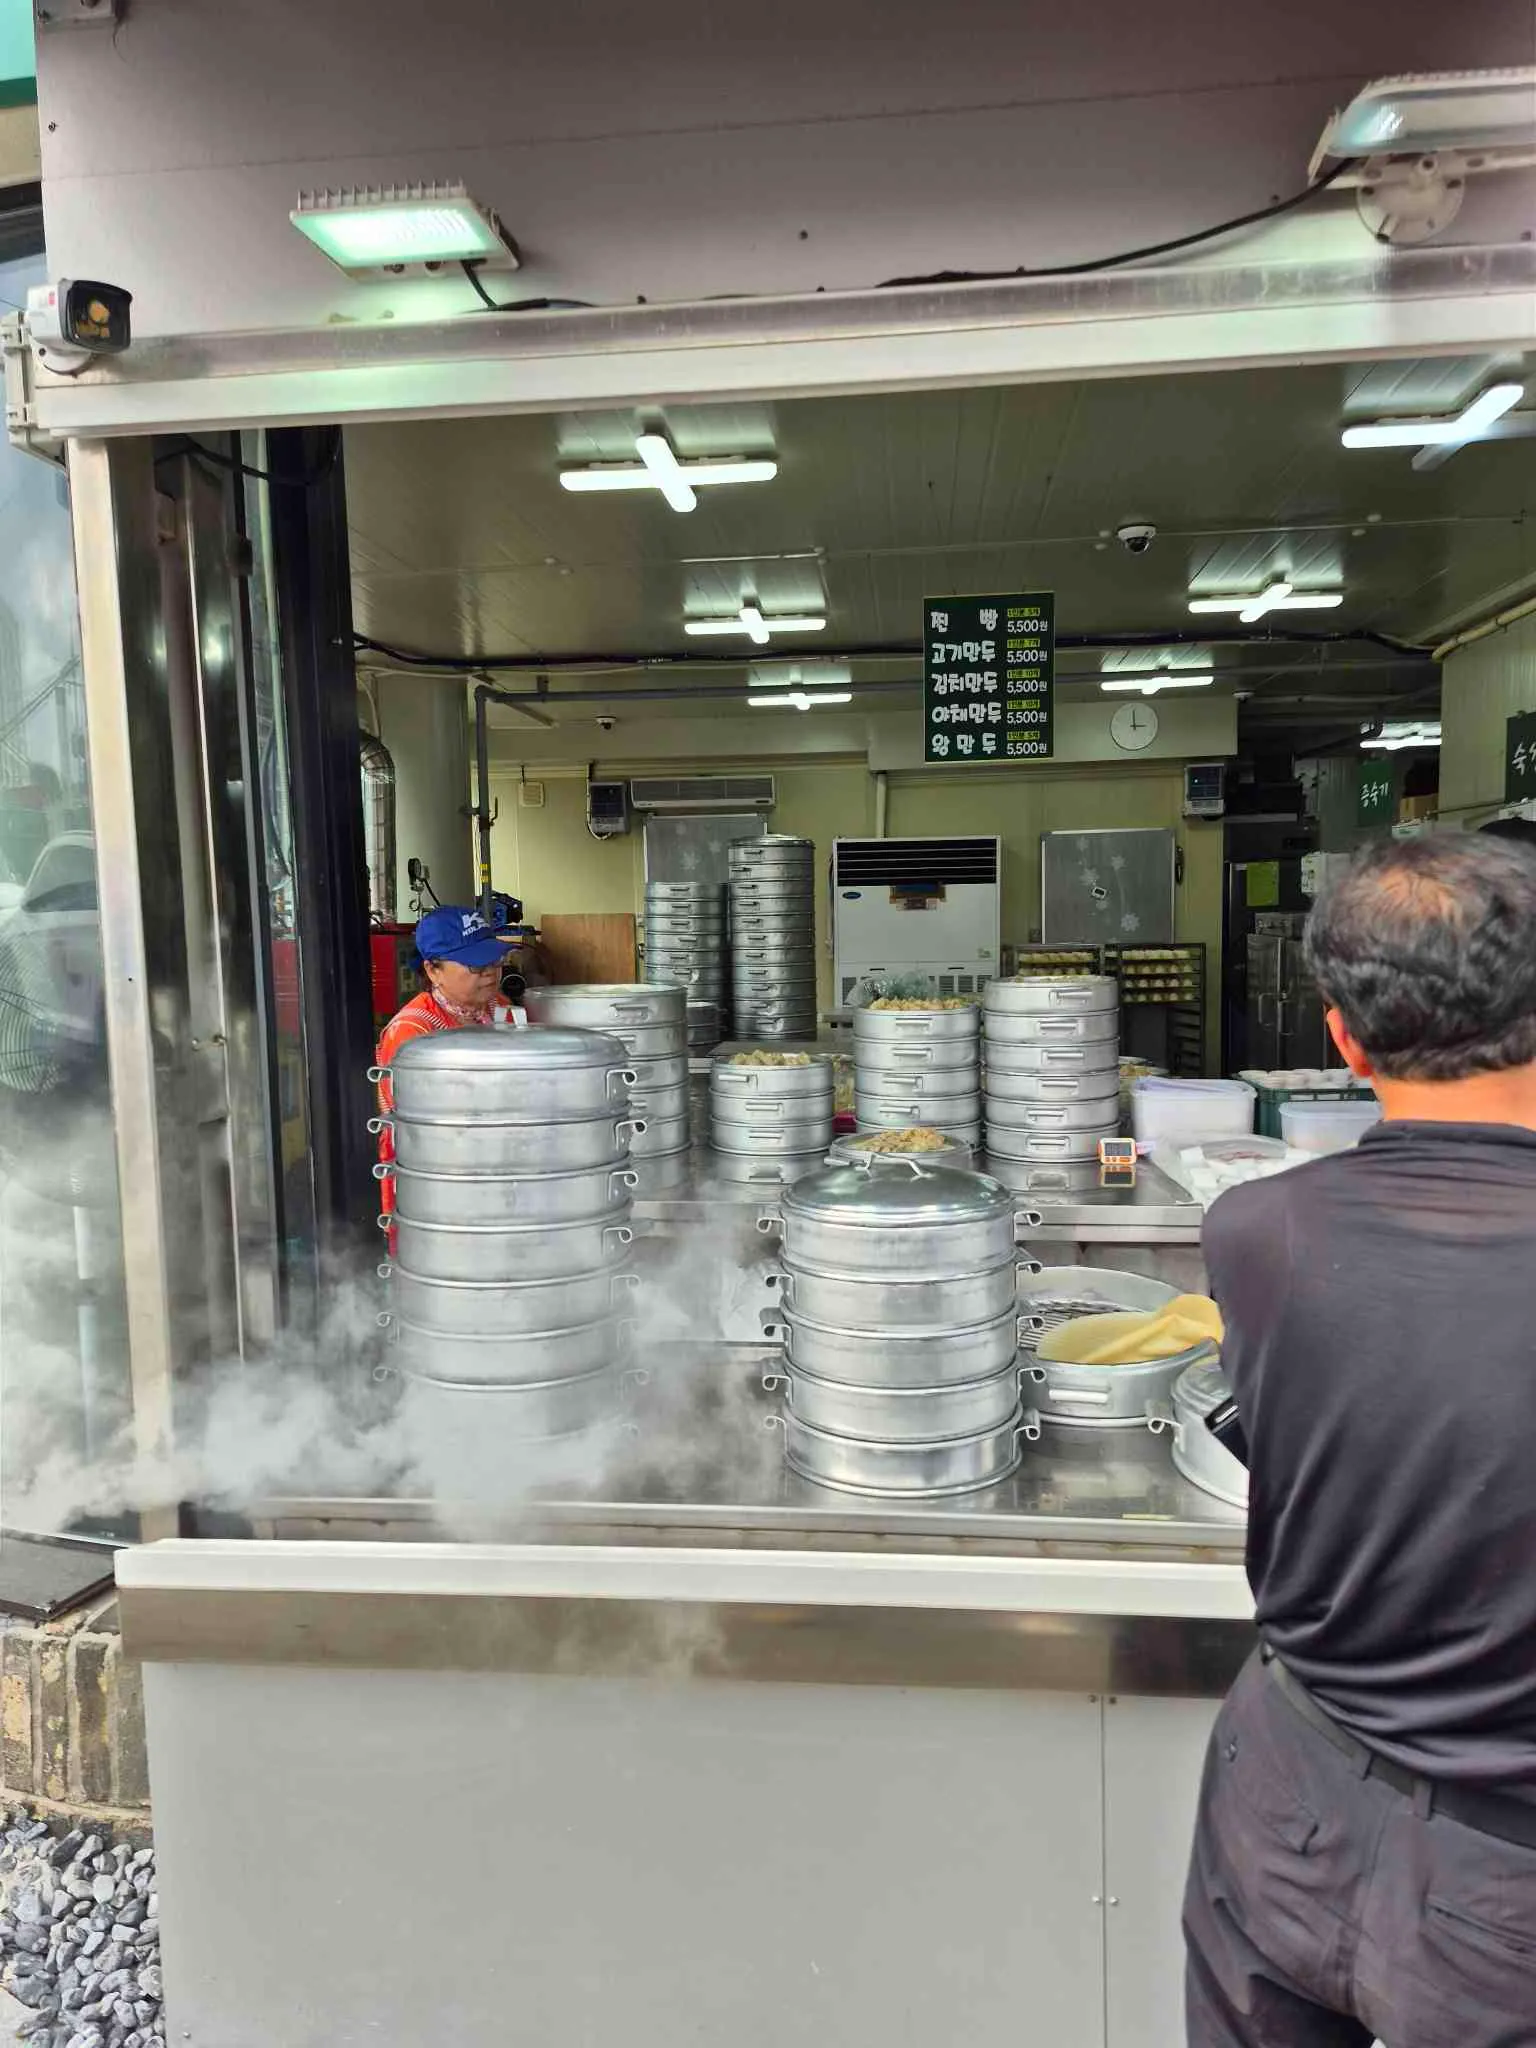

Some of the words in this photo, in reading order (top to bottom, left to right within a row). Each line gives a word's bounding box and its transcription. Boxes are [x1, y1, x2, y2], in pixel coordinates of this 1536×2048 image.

[931, 640, 996, 664] 고기만두
[931, 671, 998, 695] 김치만두
[931, 702, 1002, 724] 야채만두
